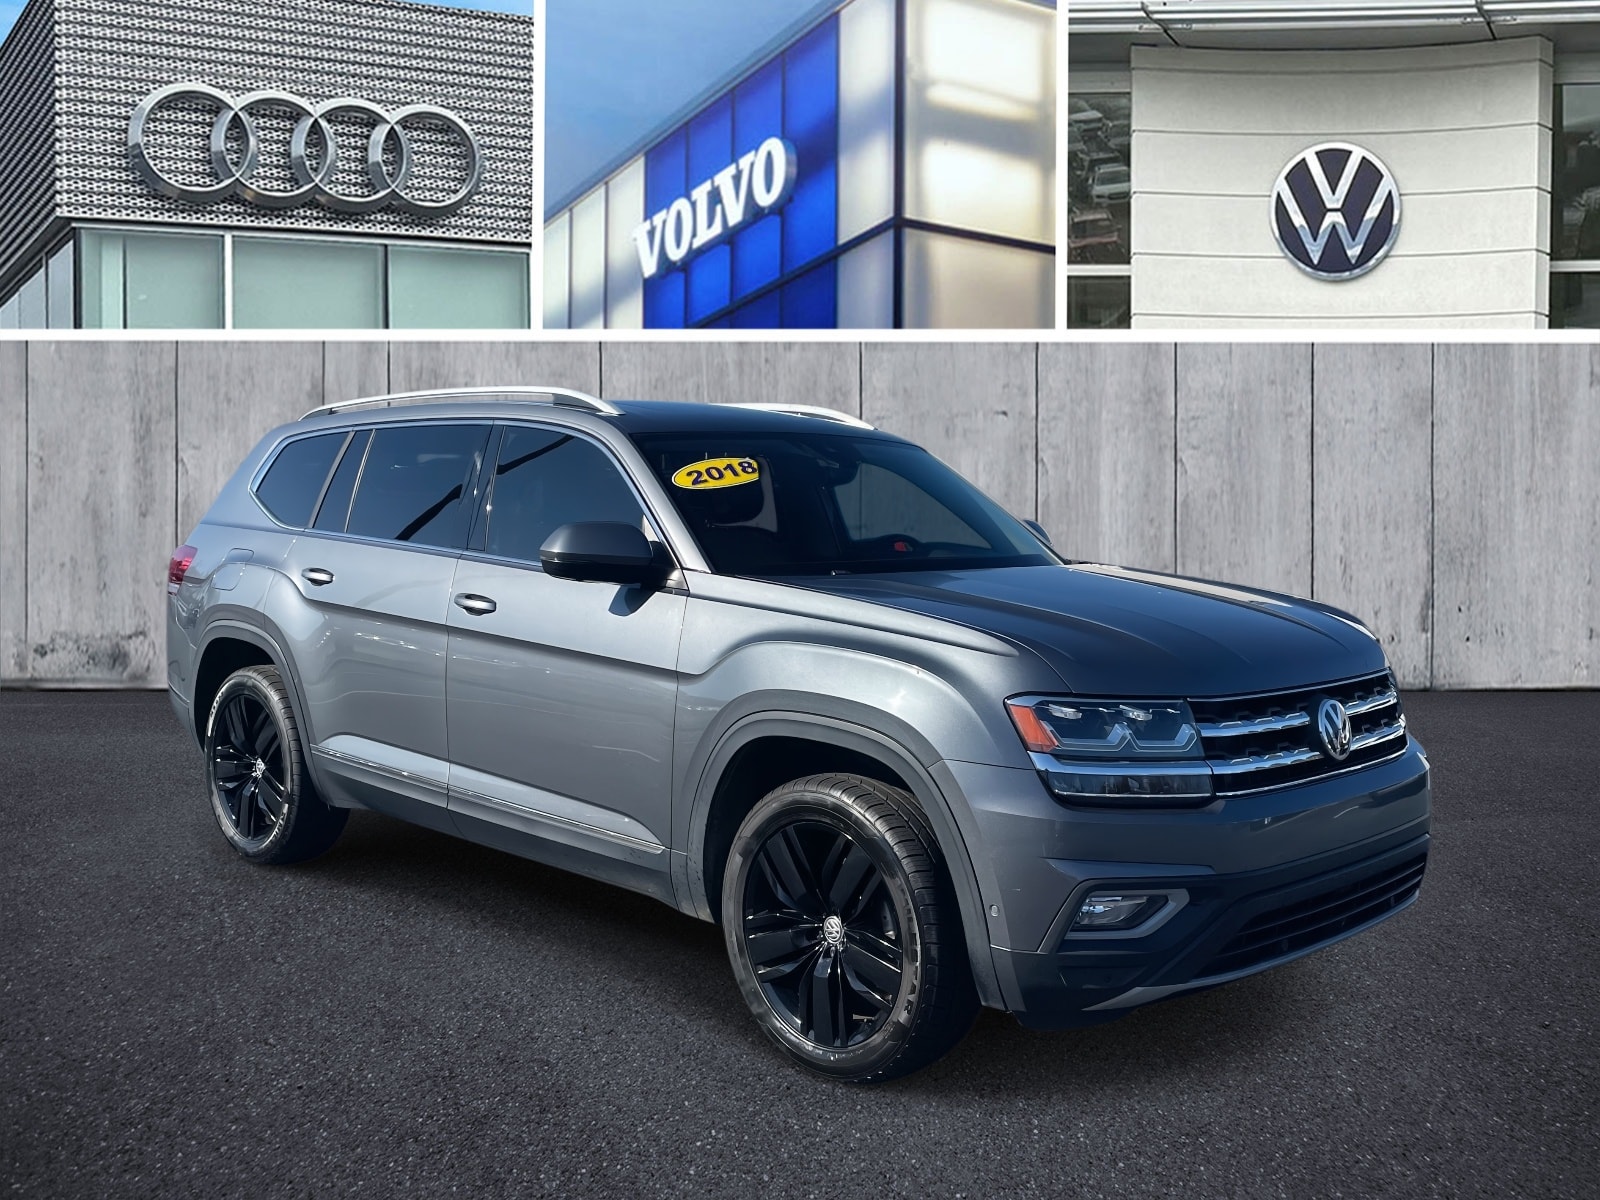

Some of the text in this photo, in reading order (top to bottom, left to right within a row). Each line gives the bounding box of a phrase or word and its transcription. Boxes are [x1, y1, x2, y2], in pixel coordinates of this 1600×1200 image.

[633, 137, 787, 279] VOLVO
[1274, 146, 1396, 271] VW
[686, 461, 757, 486] 2018
